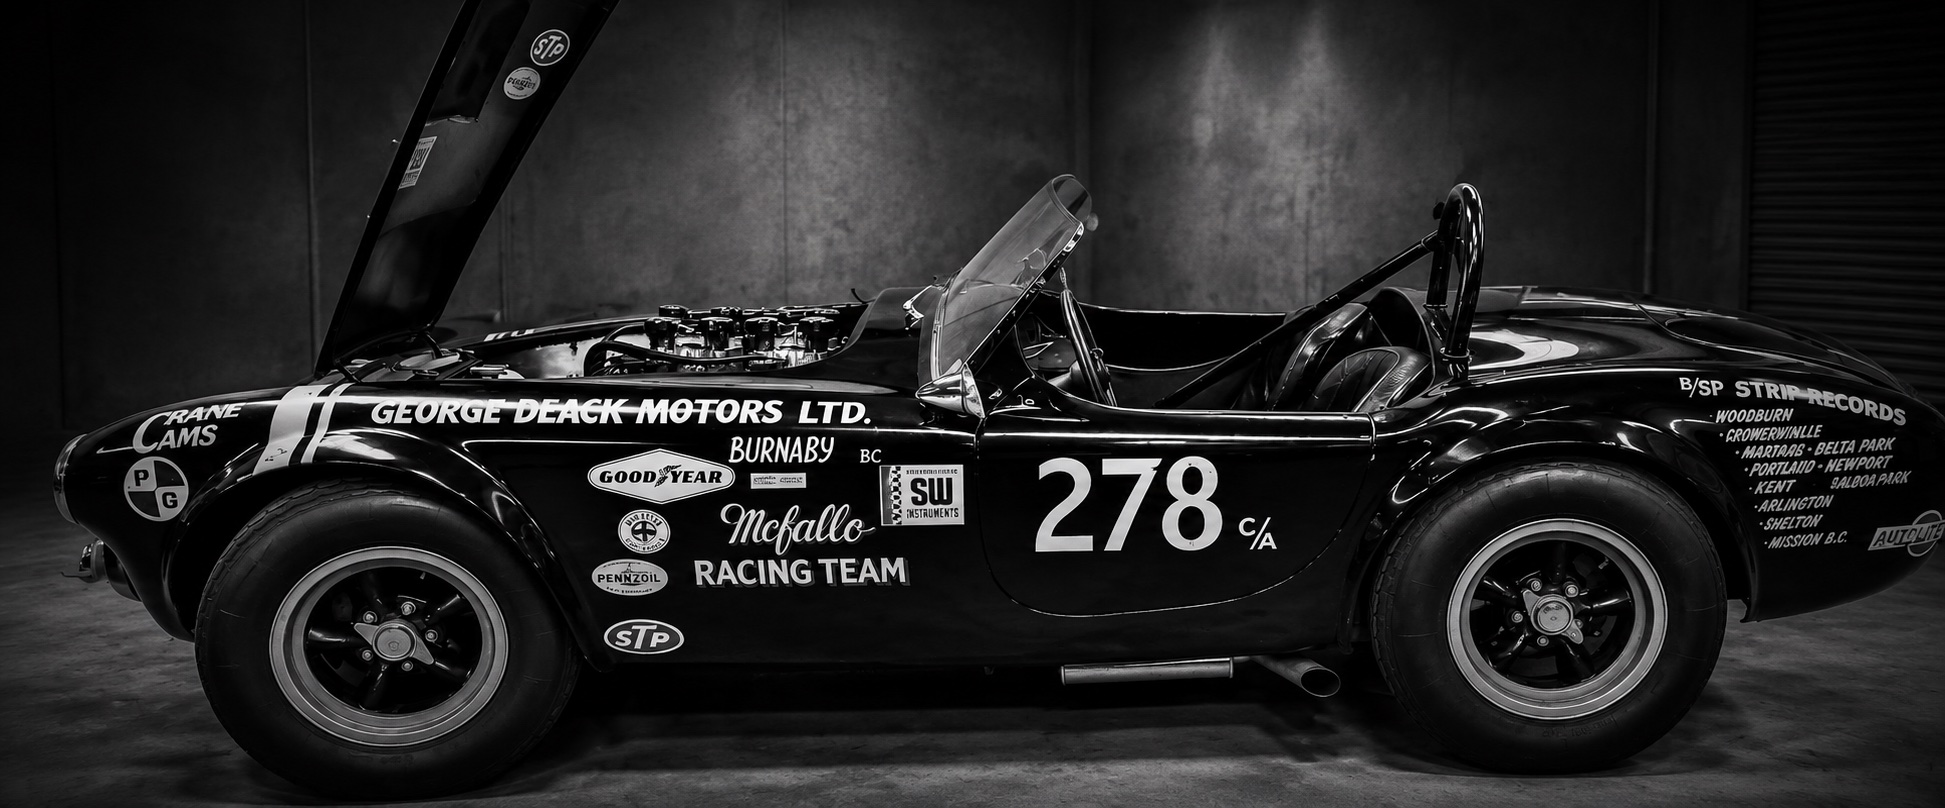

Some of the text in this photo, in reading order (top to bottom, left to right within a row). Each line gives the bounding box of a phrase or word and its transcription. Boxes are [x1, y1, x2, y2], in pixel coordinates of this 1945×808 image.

[533, 35, 565, 60] STP
[1679, 377, 1906, 426] B/SP STRIP RECORDS
[371, 398, 871, 425] GEORGE DEACK MOTORS LTD.
[1716, 408, 1794, 423] WOODBURN
[133, 402, 246, 446] CRANE
[728, 436, 882, 463] BURNABY BC
[1814, 440, 1856, 456] BELTA
[1858, 437, 1897, 453] PARK
[1824, 455, 1893, 473] NEWPORT
[133, 470, 150, 486] P
[1754, 480, 1797, 494] KENT
[1876, 470, 1912, 486] PARK
[162, 492, 179, 509] G
[910, 477, 954, 506] SW
[906, 507, 960, 519] INSTRUMENTS
[1035, 456, 1223, 552] 278
[1758, 495, 1834, 512] ARLINGTON
[1763, 514, 1823, 531] SHELTON
[1238, 517, 1278, 550] C/A
[1768, 530, 1848, 549] MISSION B.C.
[597, 572, 661, 583] PENNZOIL
[694, 557, 909, 587] RACING TEAM
[615, 624, 670, 650] STP
